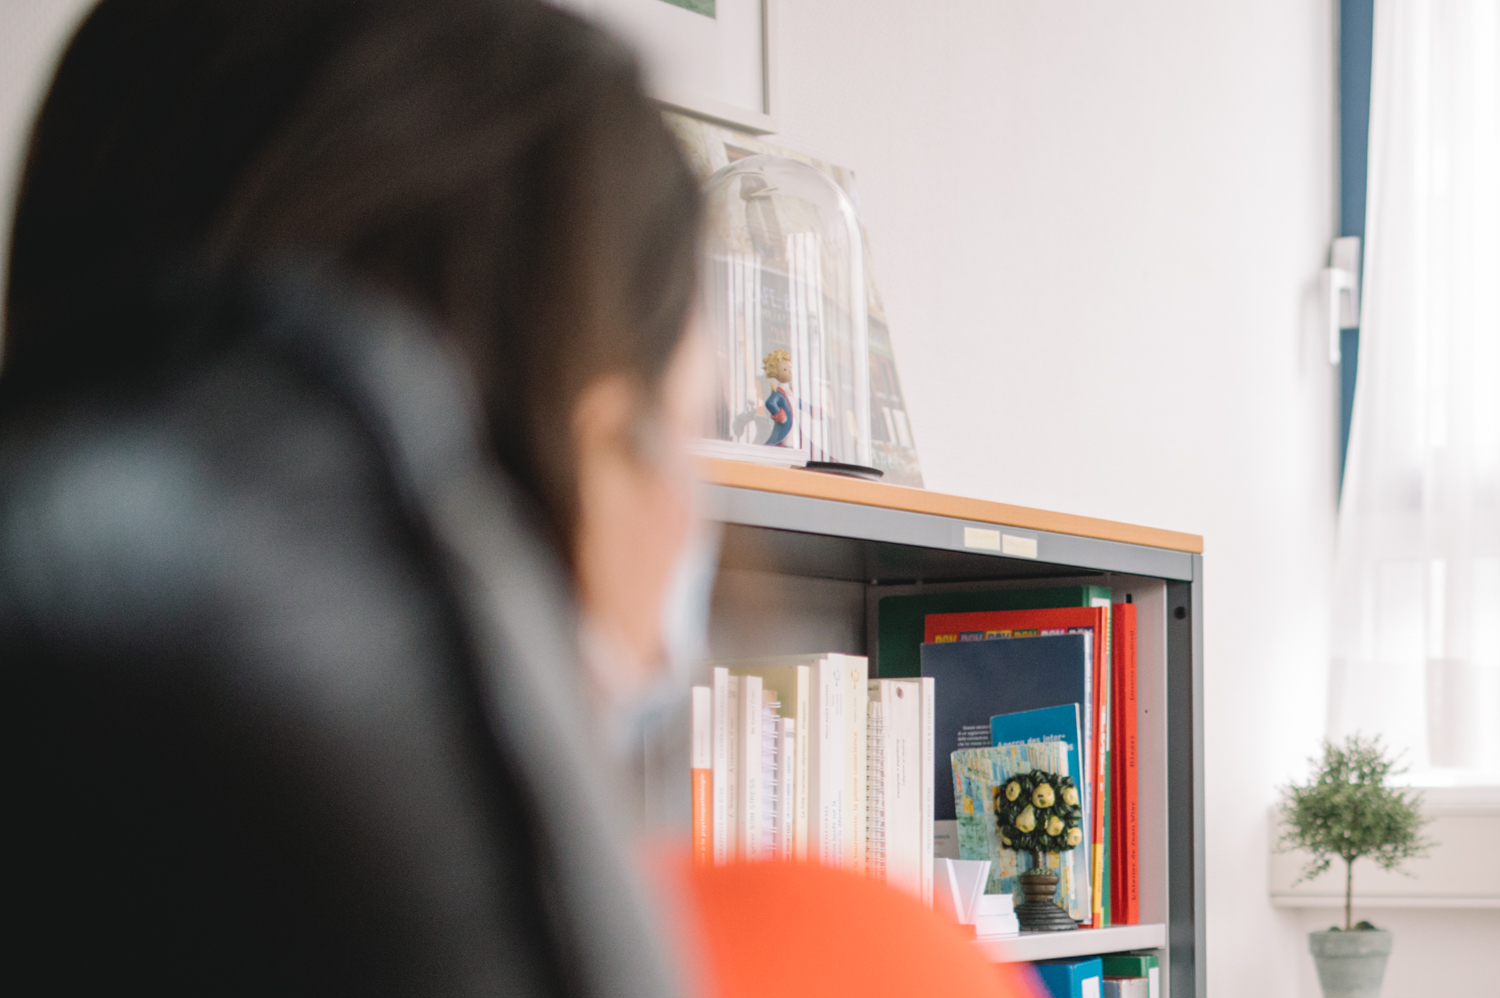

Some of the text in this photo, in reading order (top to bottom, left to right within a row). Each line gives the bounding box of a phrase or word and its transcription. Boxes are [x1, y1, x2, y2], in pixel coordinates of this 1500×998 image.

[1042, 733, 1066, 743] inter-
[699, 773, 707, 837] psychopathologie
[853, 803, 858, 811] la
